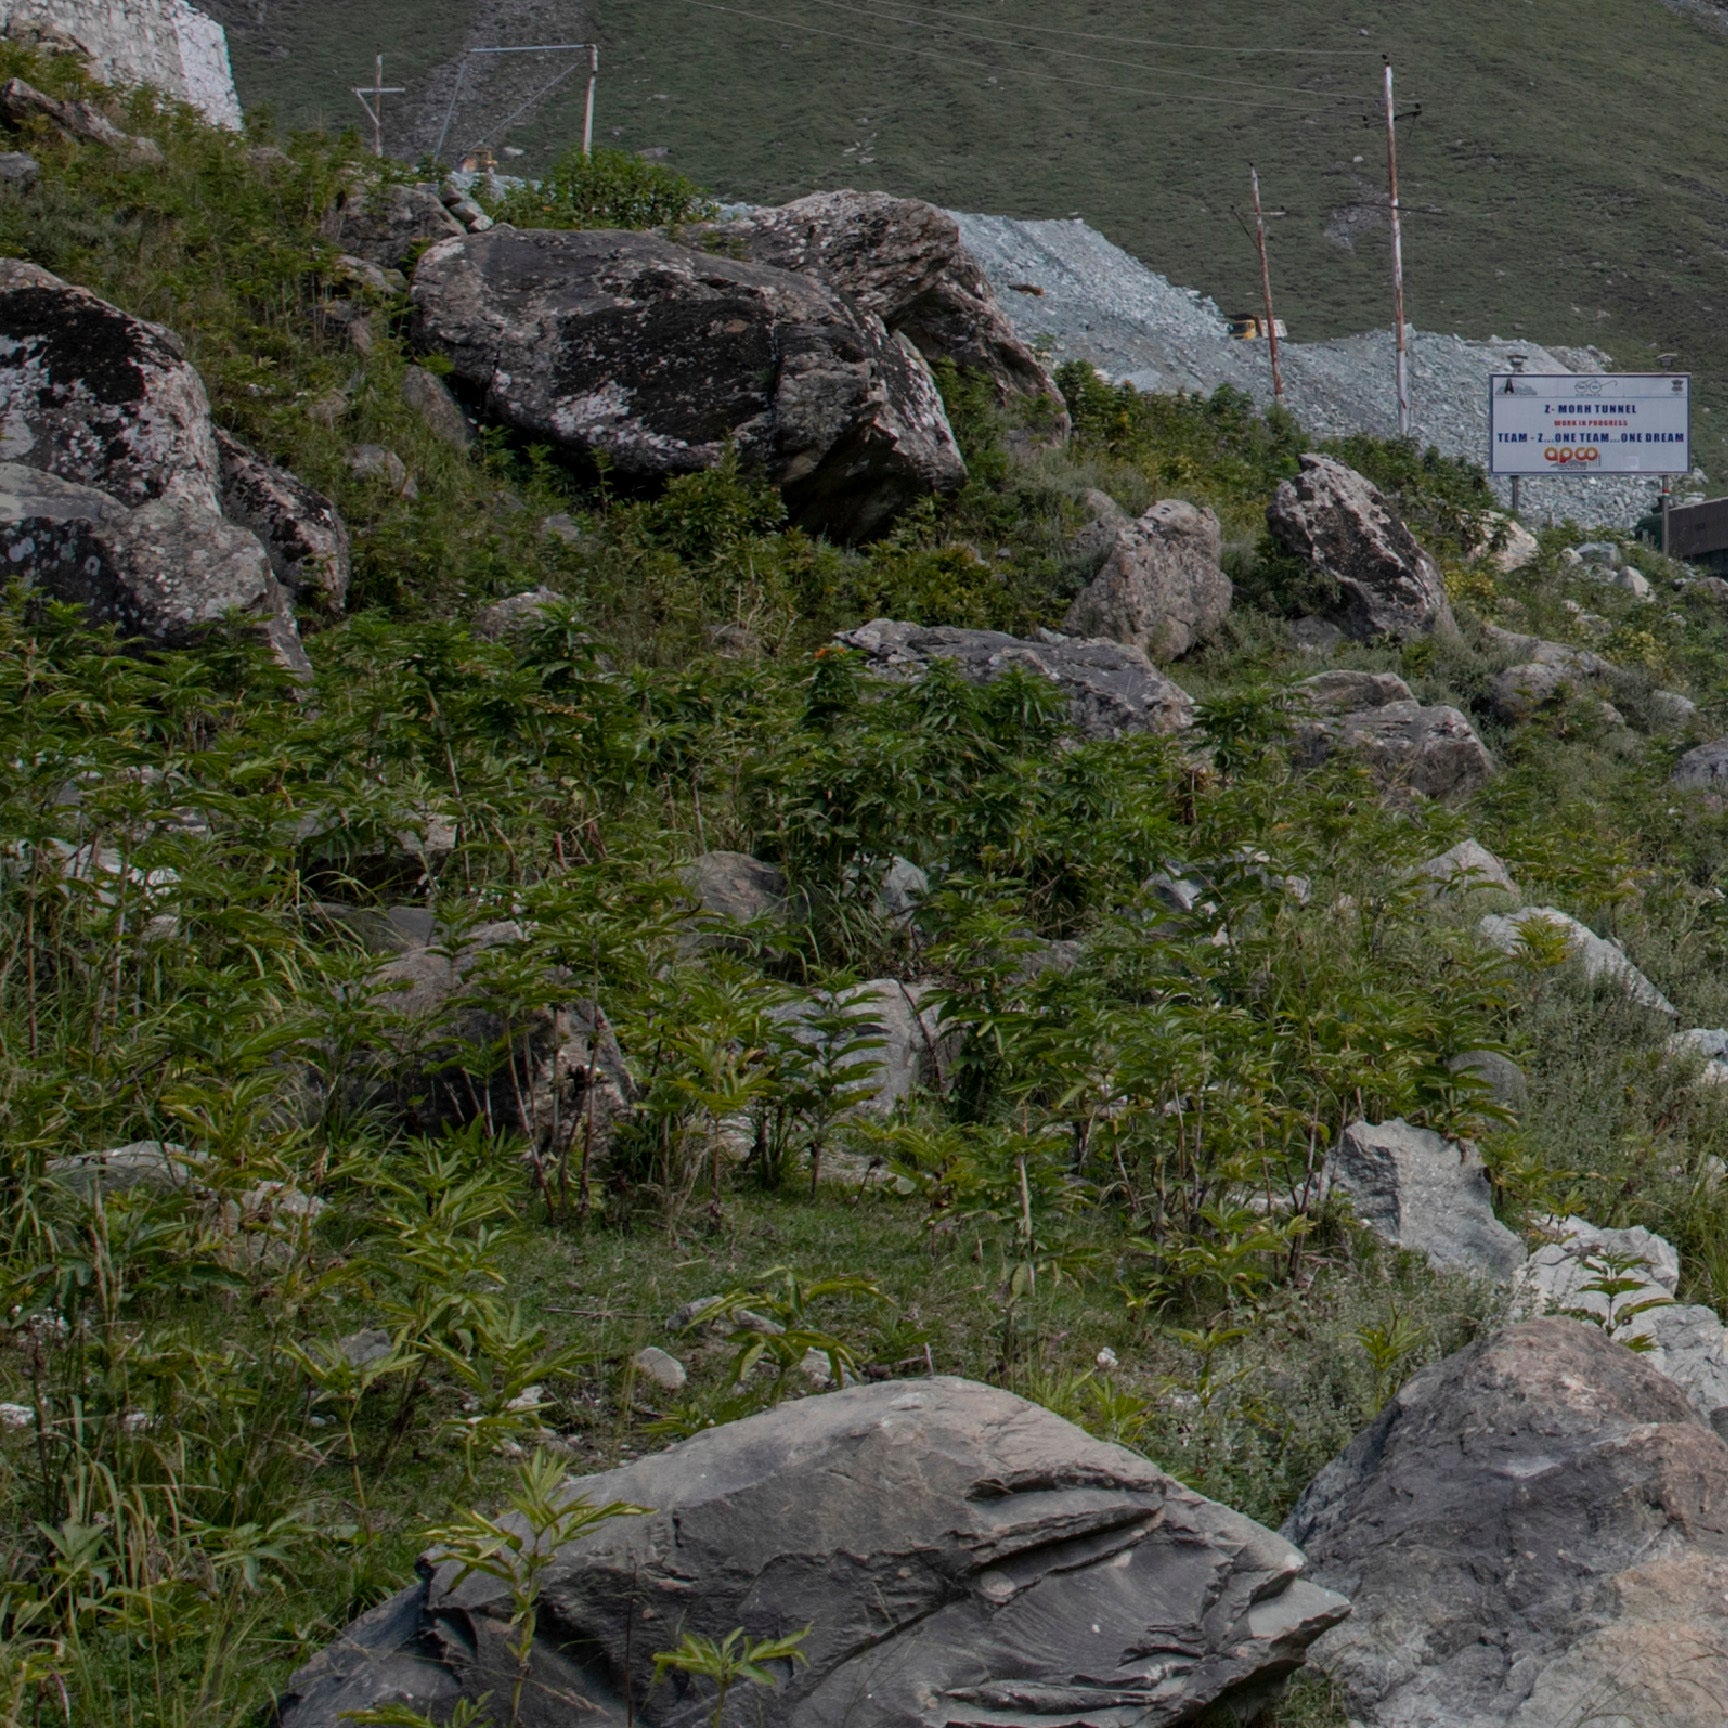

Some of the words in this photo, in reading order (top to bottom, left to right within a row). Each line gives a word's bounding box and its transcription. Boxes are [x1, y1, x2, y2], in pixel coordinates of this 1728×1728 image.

[1558, 404, 1592, 414] MORH
[1595, 404, 1637, 414] TUNNEL
[1498, 433, 1528, 443] TEAM
[1645, 433, 1684, 443] DREAM
[1544, 446, 1599, 463] apco
